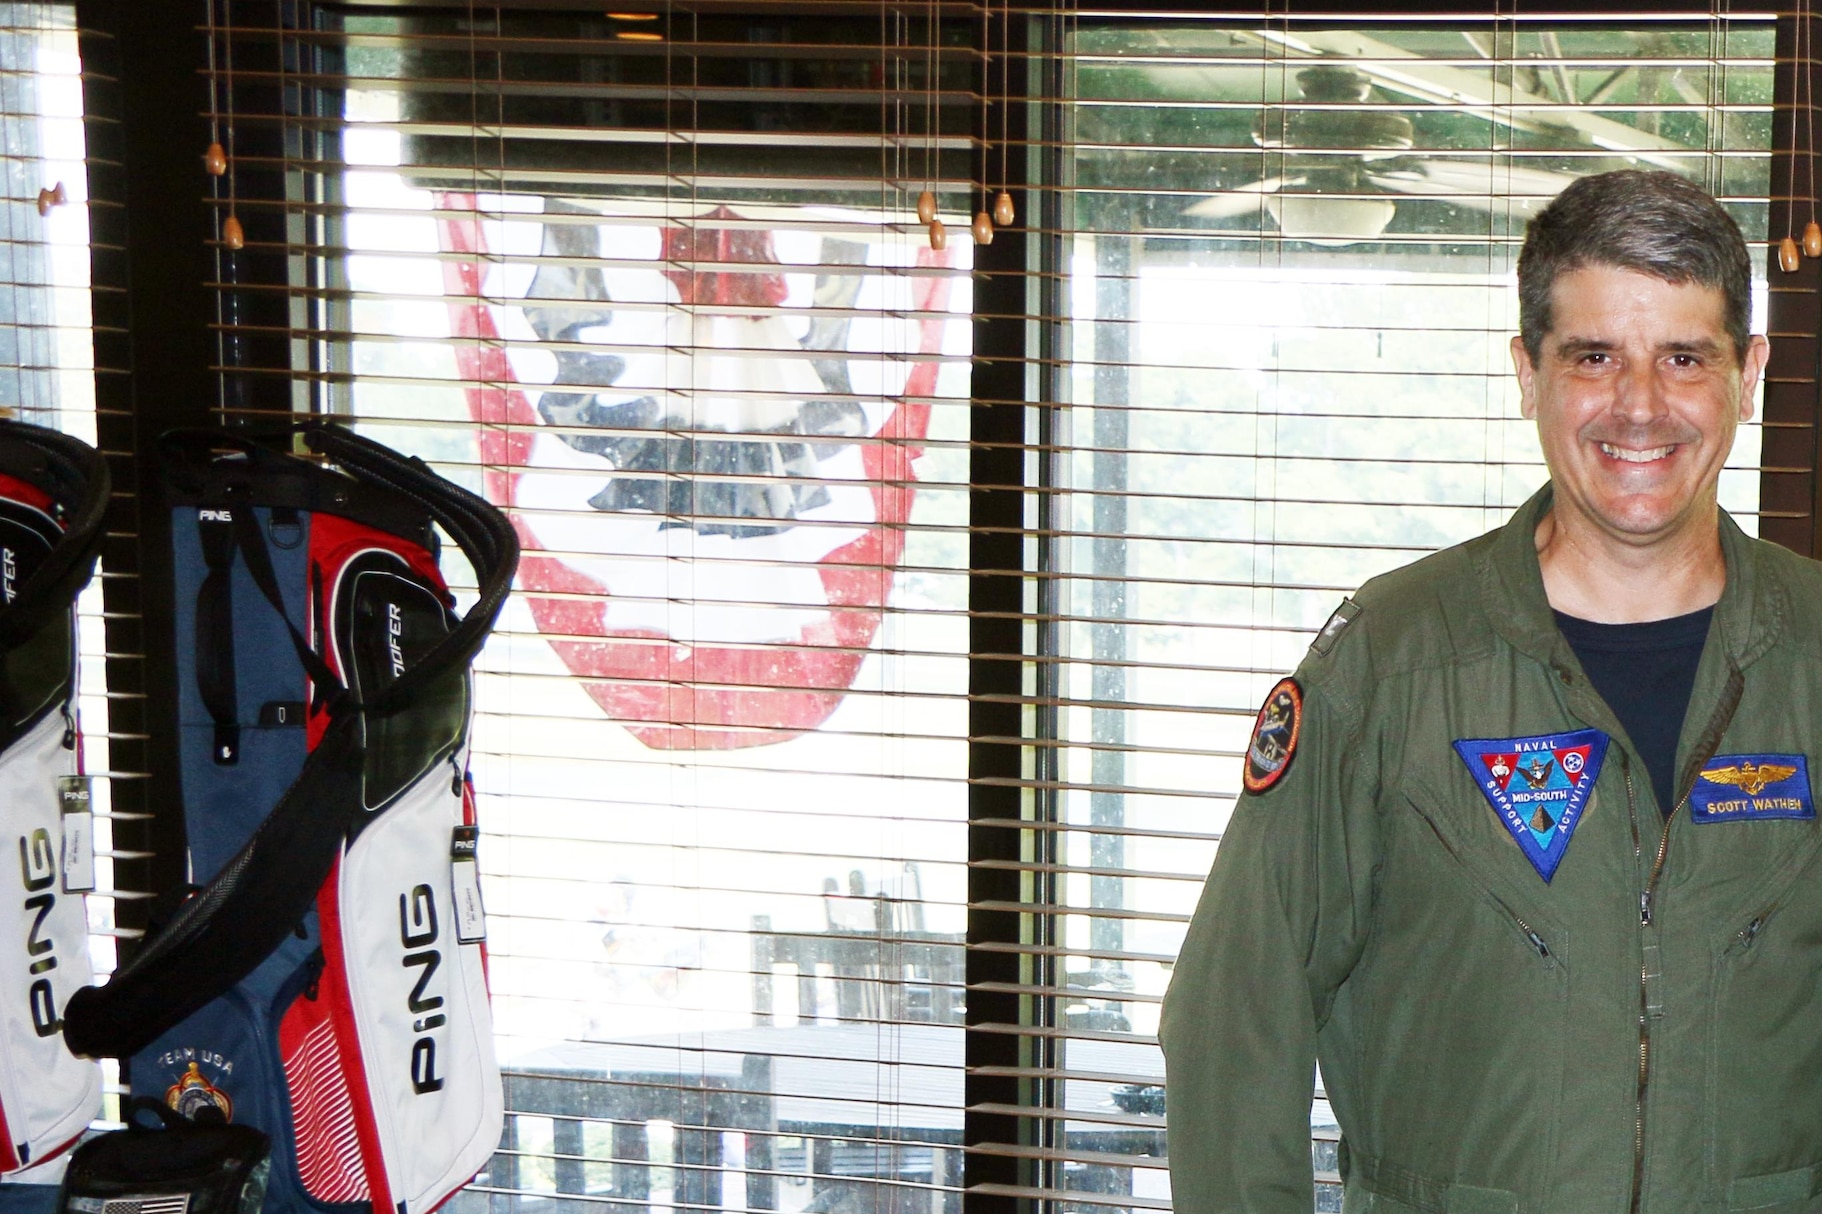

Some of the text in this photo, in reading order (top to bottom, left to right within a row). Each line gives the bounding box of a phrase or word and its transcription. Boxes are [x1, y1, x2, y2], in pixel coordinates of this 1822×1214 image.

[200, 509, 233, 522] PING
[388, 603, 406, 678] OOFER
[1514, 740, 1557, 753] NAVAL
[64, 791, 90, 801] PING
[1486, 780, 1528, 834] SUPPORT
[1511, 790, 1568, 803] MID-SOUTH
[1557, 772, 1590, 834] ACTIVITY
[1706, 800, 1748, 815] SCOTT
[454, 840, 476, 849] PING
[20, 827, 62, 1037] PING
[399, 883, 447, 1096] PING
[158, 1047, 234, 1076] TEAM USA
